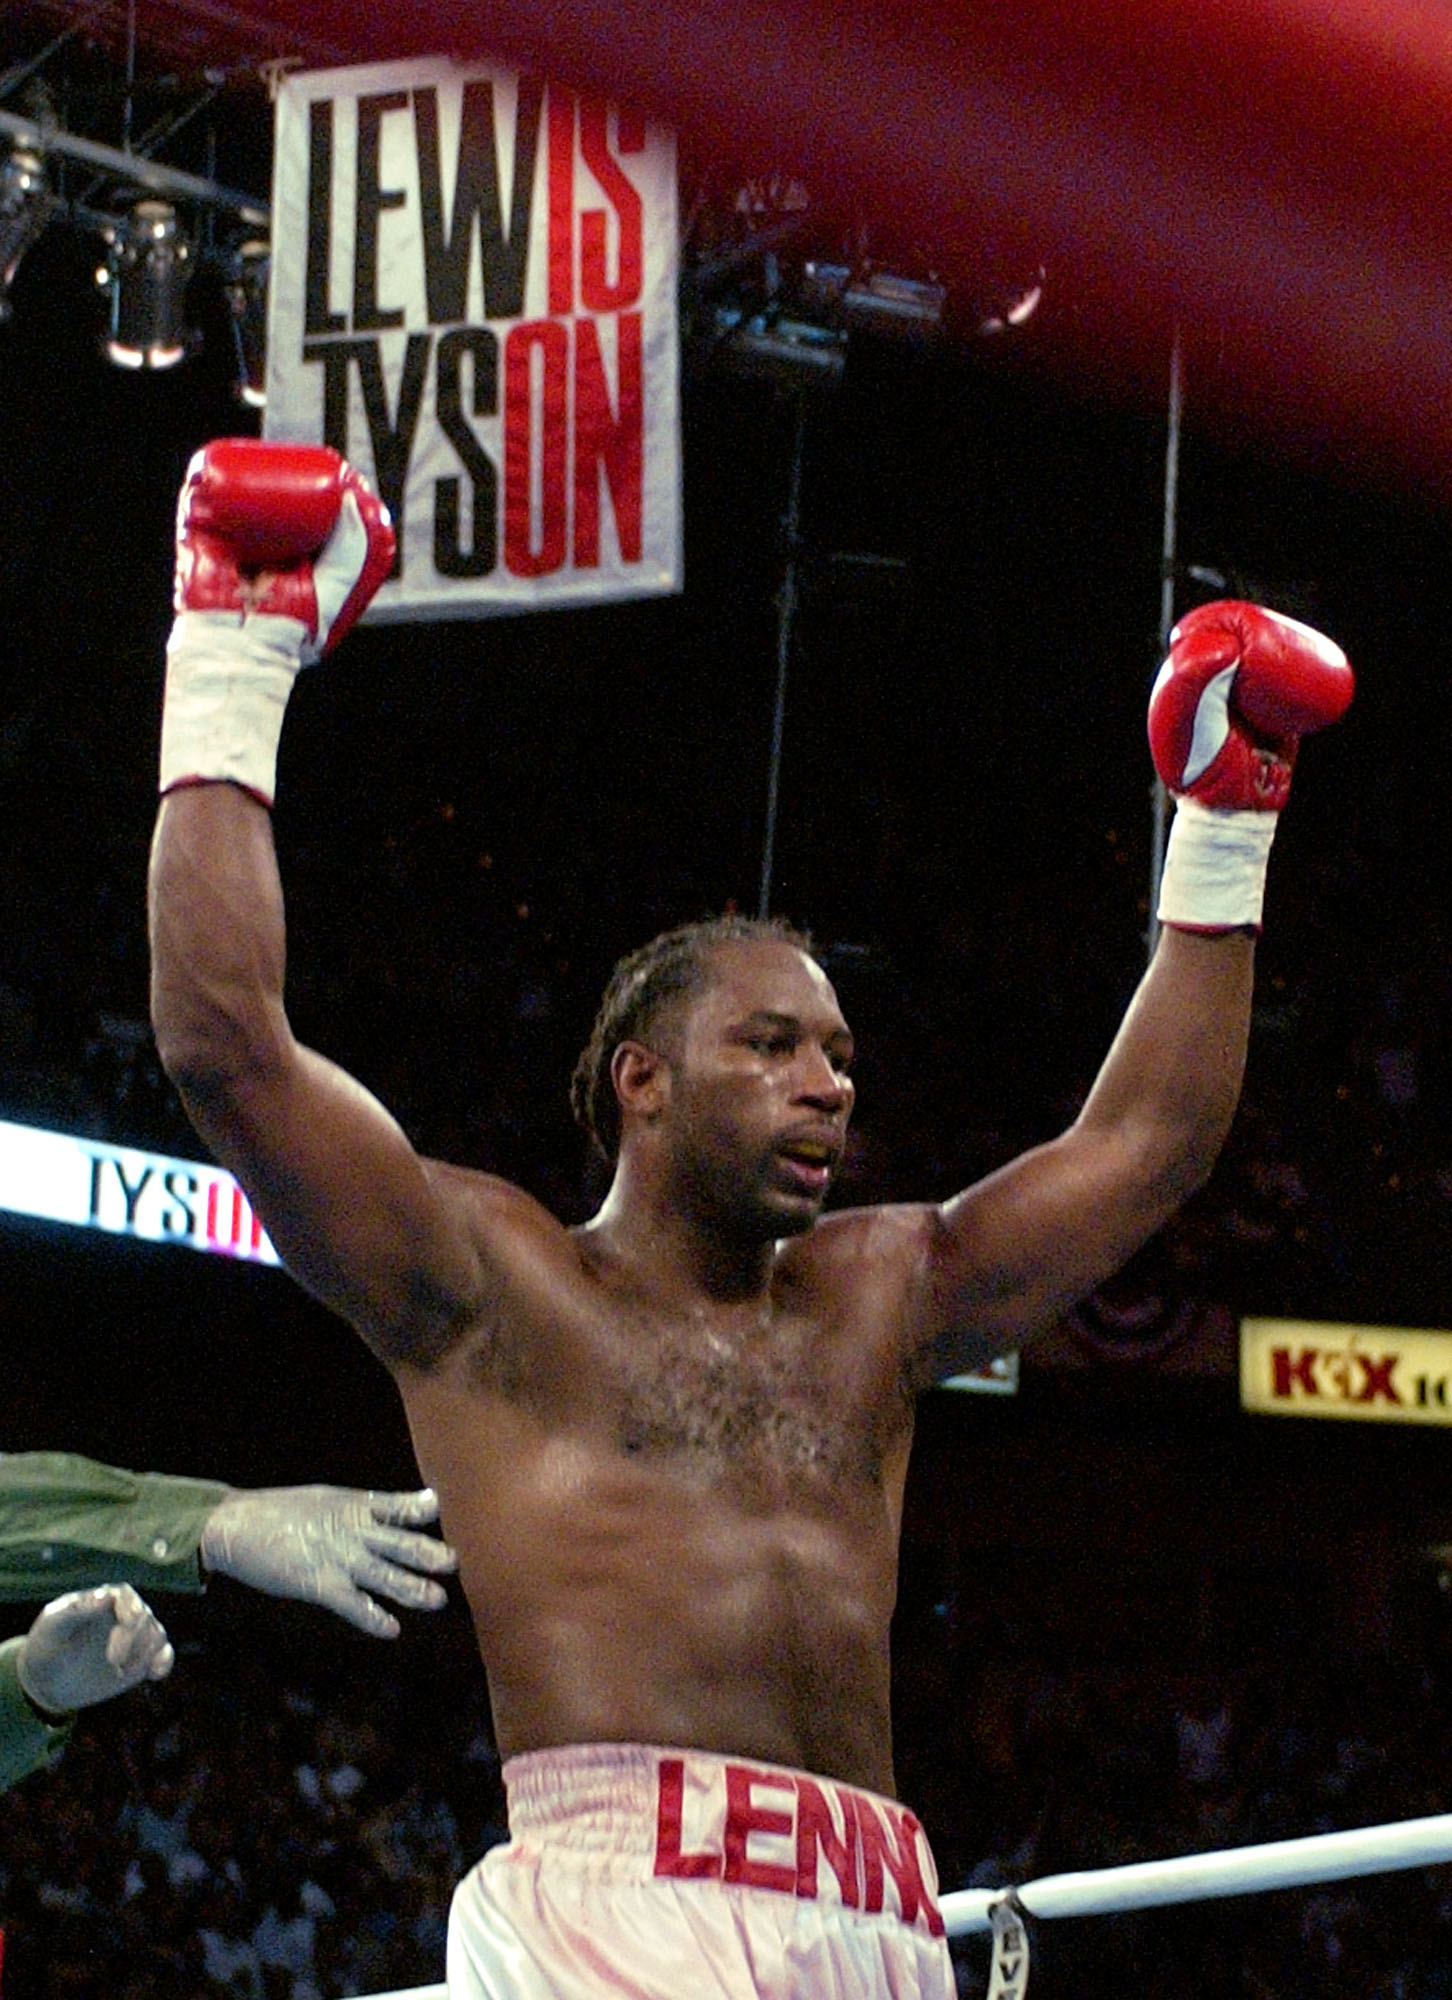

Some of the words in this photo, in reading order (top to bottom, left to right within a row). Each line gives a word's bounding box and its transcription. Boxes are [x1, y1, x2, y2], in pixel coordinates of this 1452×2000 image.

[303, 78, 646, 335] LEWIS
[303, 312, 645, 583] TYSON
[653, 1759, 946, 1938] LENN
